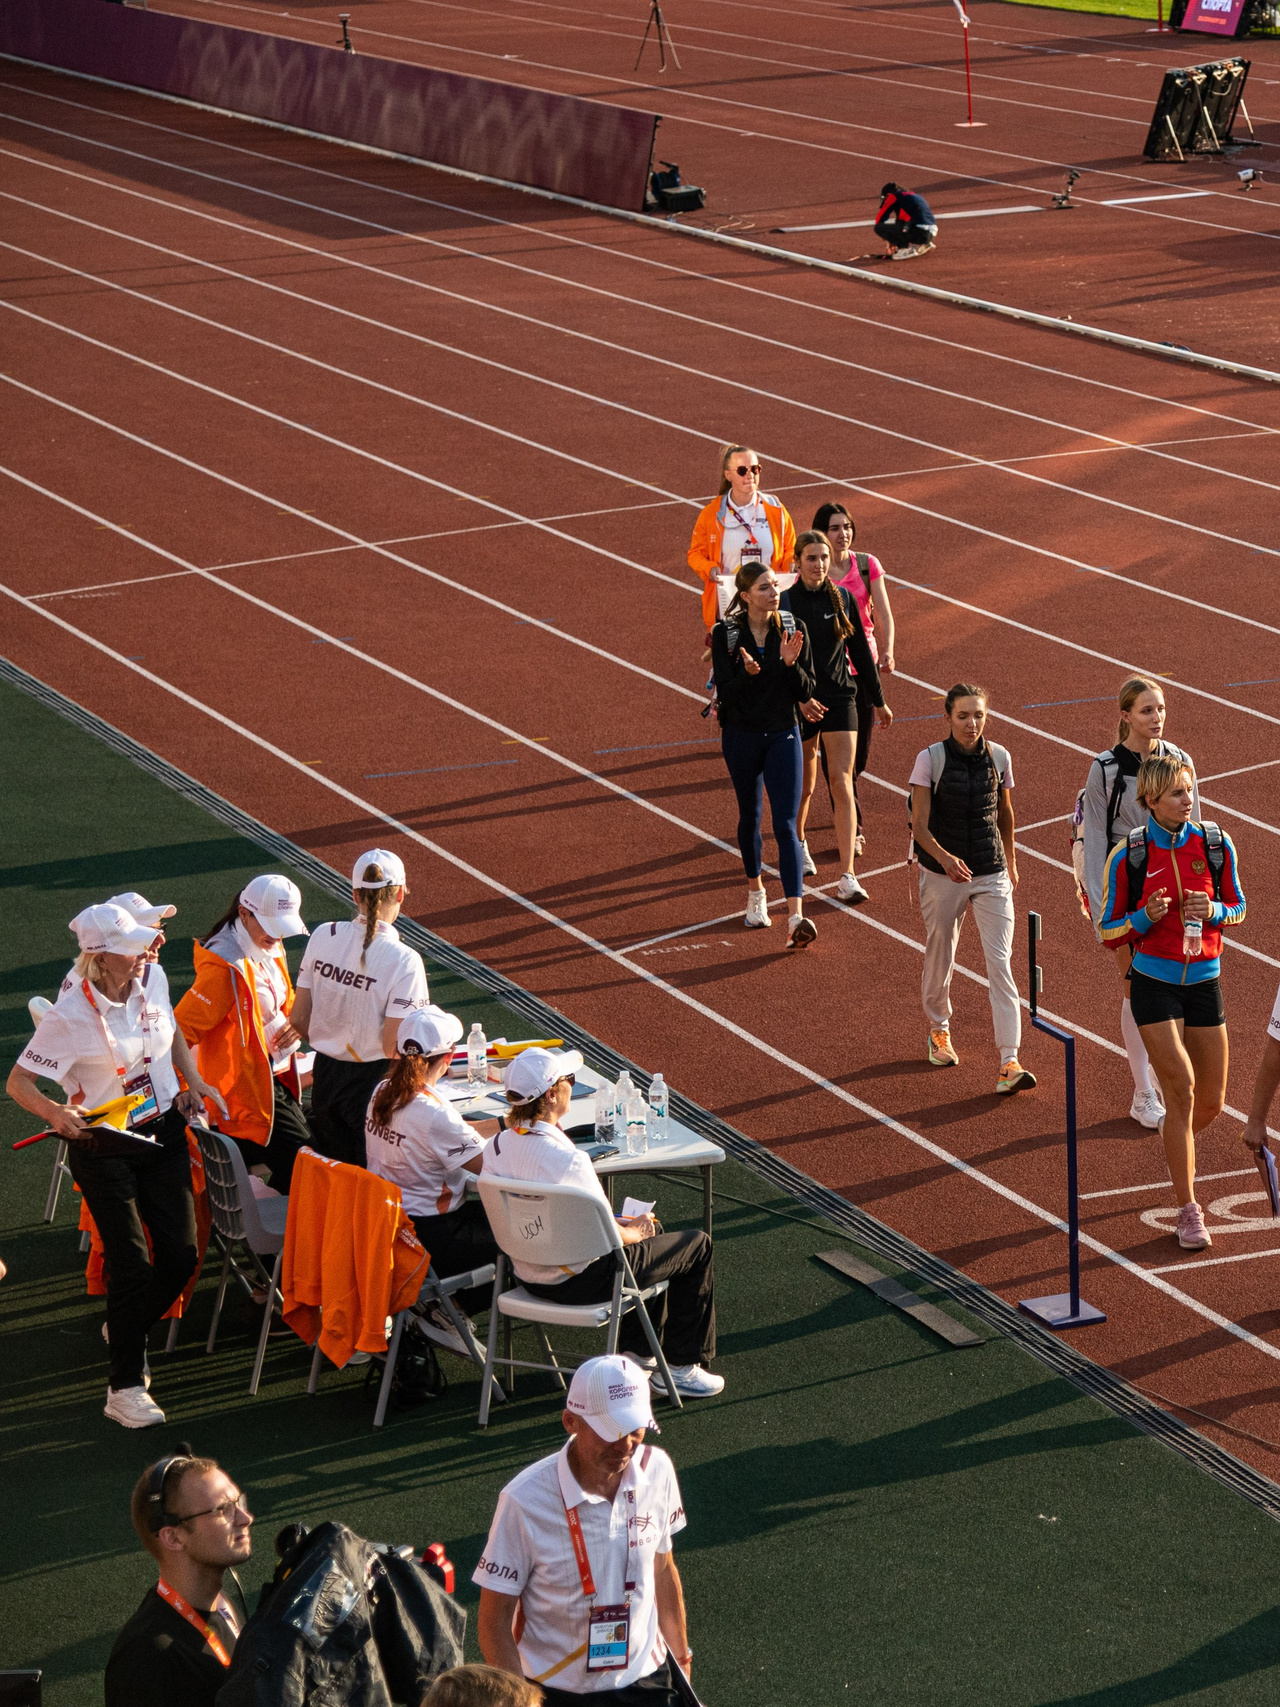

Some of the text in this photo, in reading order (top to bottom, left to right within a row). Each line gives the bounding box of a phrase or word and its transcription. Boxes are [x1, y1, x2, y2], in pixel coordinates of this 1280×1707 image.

[314, 960, 378, 992] FONBET
[25, 1049, 59, 1070] ВФЛА
[365, 1117, 407, 1147] FONBET
[608, 1385, 639, 1395] КОРОЛЕВА
[609, 1392, 634, 1401] СПОРТА
[478, 1556, 519, 1582] ВФЛА
[591, 1645, 611, 1657] 1234
